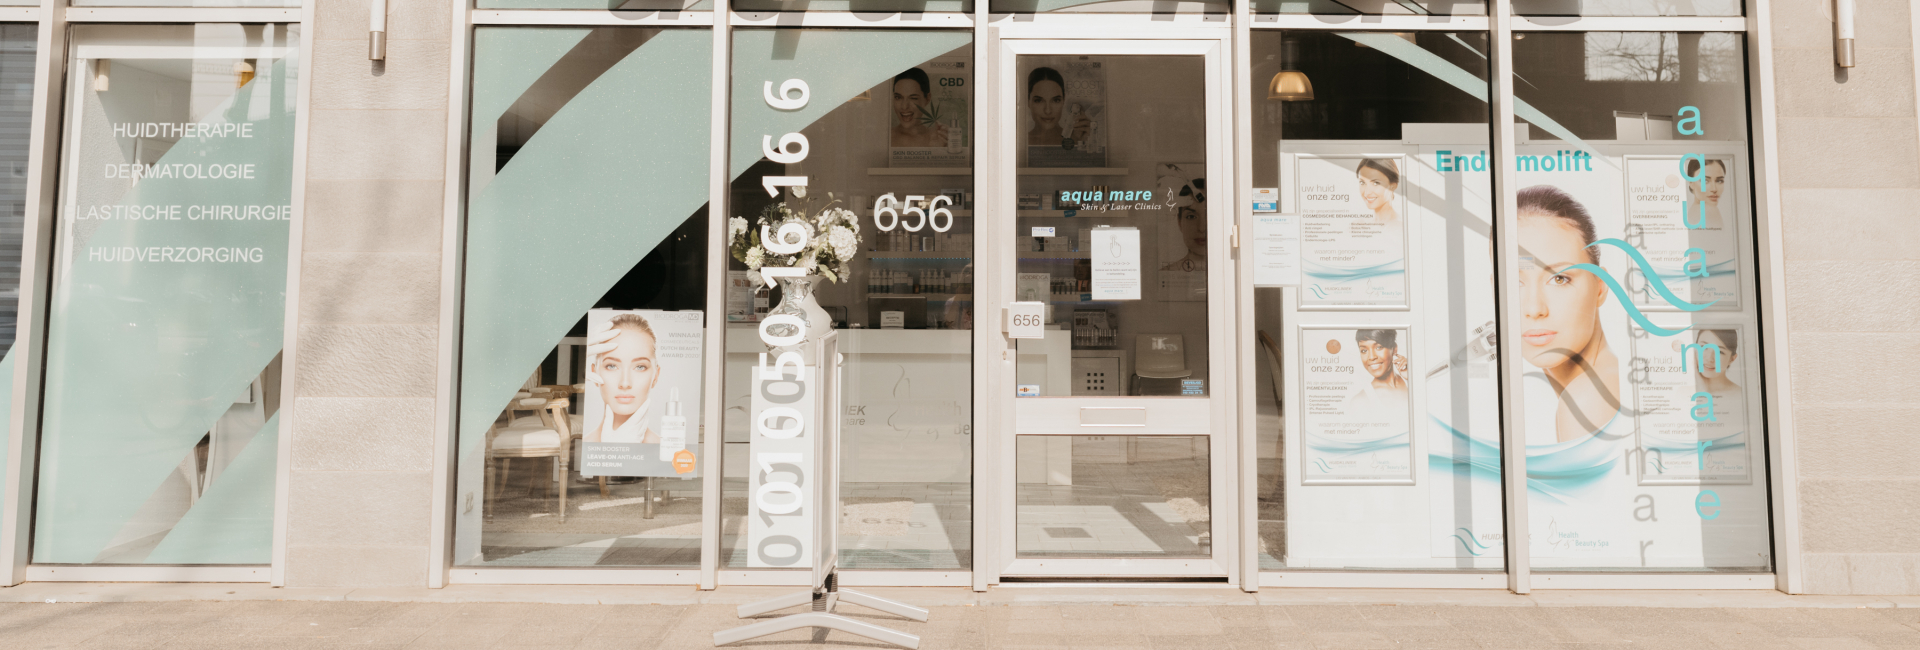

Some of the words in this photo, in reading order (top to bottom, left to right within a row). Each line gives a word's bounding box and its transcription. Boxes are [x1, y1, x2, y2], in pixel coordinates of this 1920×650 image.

[939, 78, 965, 87] CBD
[763, 78, 810, 110] 6
[113, 122, 253, 138] HUIDTHERAPIE
[762, 132, 810, 199] 16
[1436, 150, 1592, 172] Endmolift
[104, 163, 255, 179] DERMATOLOGIE
[1316, 184, 1335, 192] huid
[1646, 185, 1665, 193] huid
[1676, 105, 1710, 278] aqua
[1061, 190, 1103, 204] aqua
[1109, 190, 1152, 201] mare
[1330, 194, 1350, 202] zorg
[1660, 195, 1680, 203] zorg
[187, 205, 292, 221] CHIRURGIE
[874, 194, 954, 232] 656
[1080, 203, 1098, 211] Skin
[89, 247, 264, 263] HUIDVERZORGING
[761, 222, 807, 290] 16
[1013, 314, 1040, 326] 656
[758, 313, 806, 381] 50
[1321, 356, 1339, 364] huid
[1653, 356, 1672, 364] huid
[1335, 365, 1354, 374] zorg
[1679, 342, 1722, 520] mare
